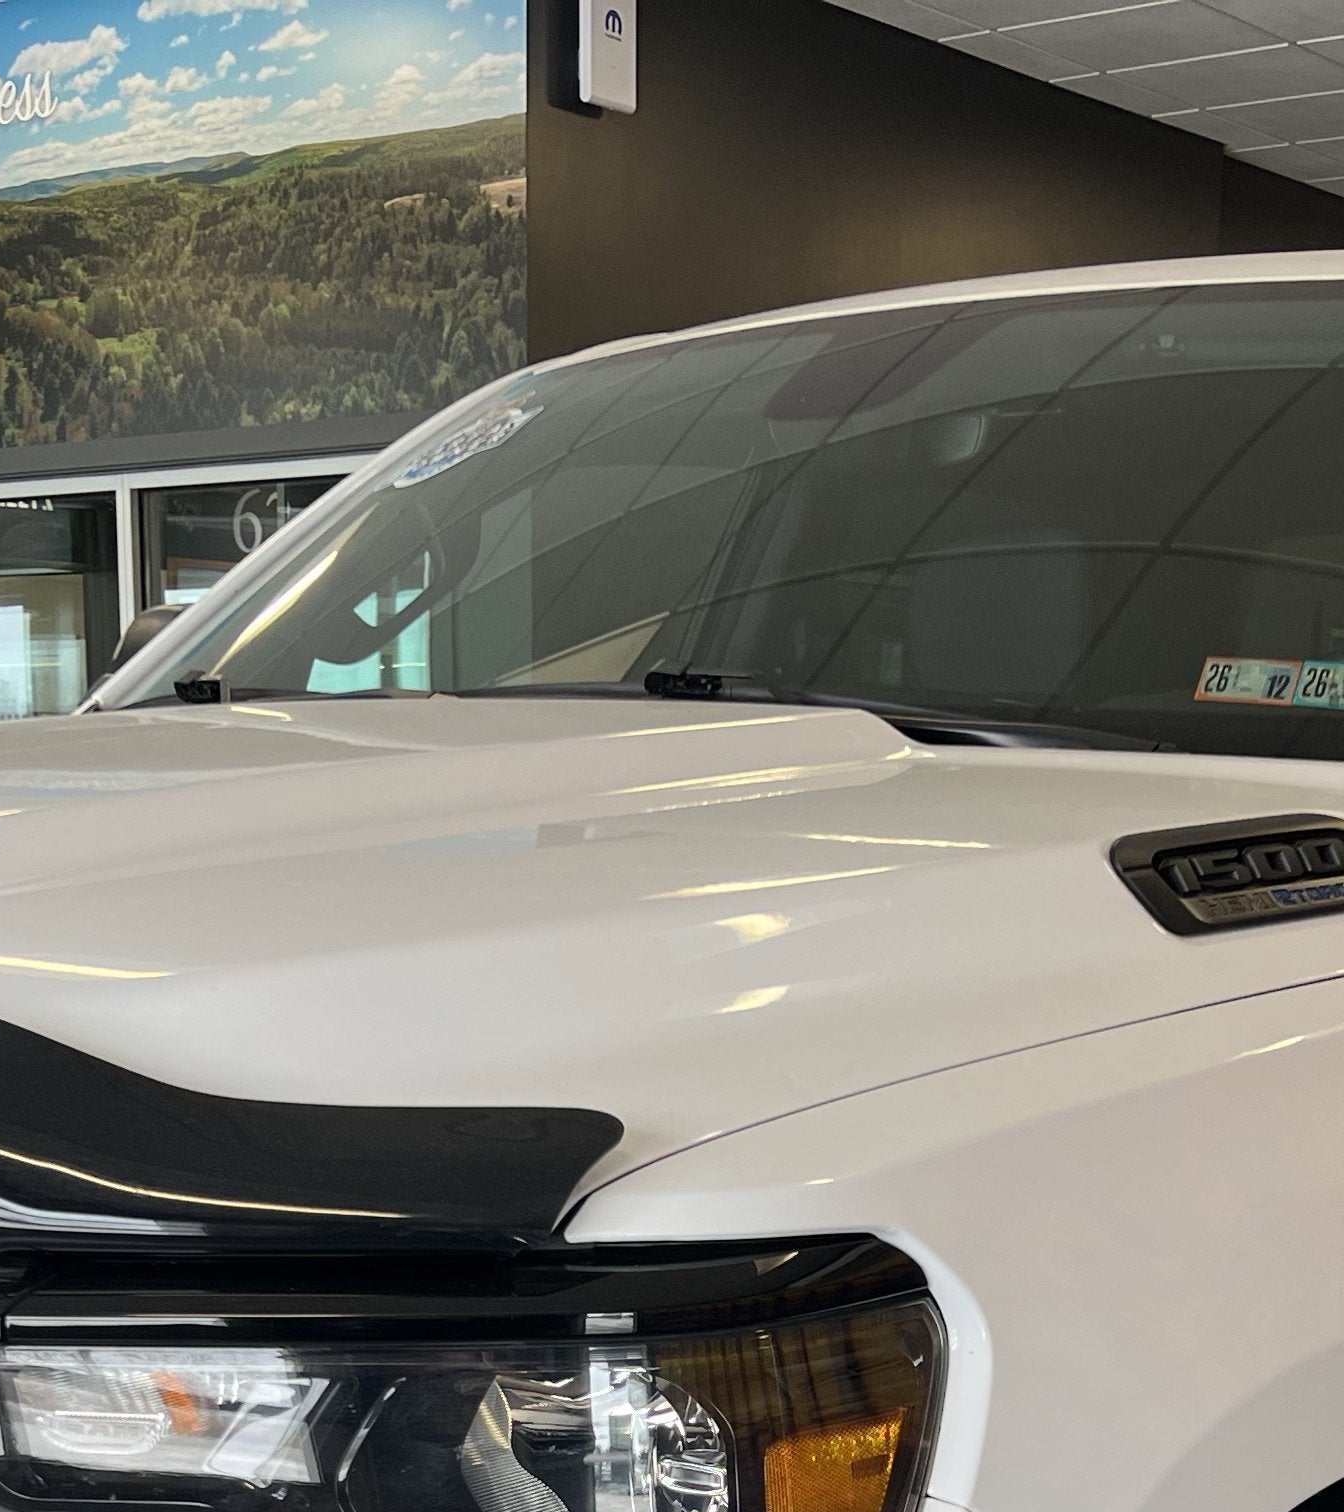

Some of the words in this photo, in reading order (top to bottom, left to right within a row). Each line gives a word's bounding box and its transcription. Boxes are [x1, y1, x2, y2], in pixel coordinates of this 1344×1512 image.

[1204, 664, 1233, 693] 26
[1266, 674, 1291, 700] 12
[1302, 668, 1331, 698] 26
